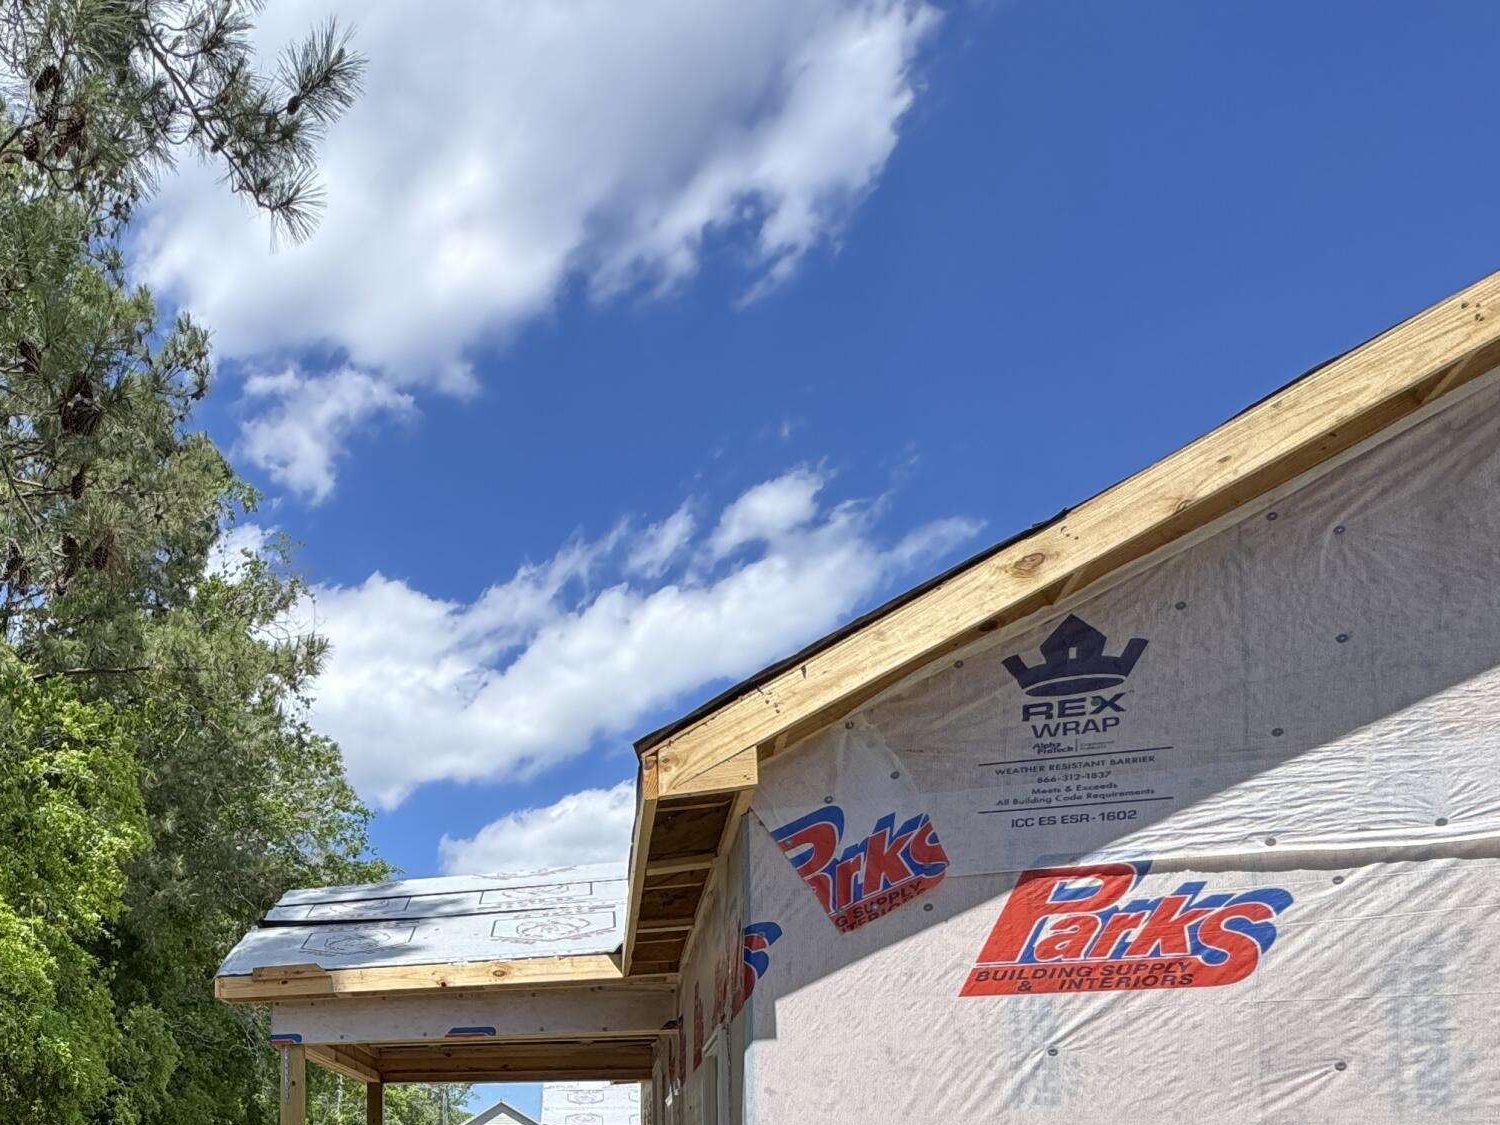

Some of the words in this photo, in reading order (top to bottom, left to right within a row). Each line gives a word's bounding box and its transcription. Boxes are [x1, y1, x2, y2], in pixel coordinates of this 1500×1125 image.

[1021, 692, 1126, 722] REX
[1031, 716, 1120, 739] WRAP
[995, 764, 1045, 776] WEATHER
[1049, 759, 1106, 771] RESISTANT
[1110, 755, 1155, 766] BARRIER
[1037, 771, 1111, 784] 866-312-1837
[996, 798, 1010, 806] All
[1012, 795, 1052, 806] Building
[1055, 792, 1083, 802] Code
[1086, 787, 1155, 800] Requirements
[1031, 786, 1061, 795] Meets
[1076, 782, 1118, 792] Exceeds
[1011, 817, 1035, 829] ICC
[1038, 816, 1057, 826] ES
[975, 966, 1092, 982] BUILDING
[1099, 961, 1193, 977] SUPPLY
[1017, 980, 1032, 992] &
[1059, 973, 1194, 990] INTERIORS
